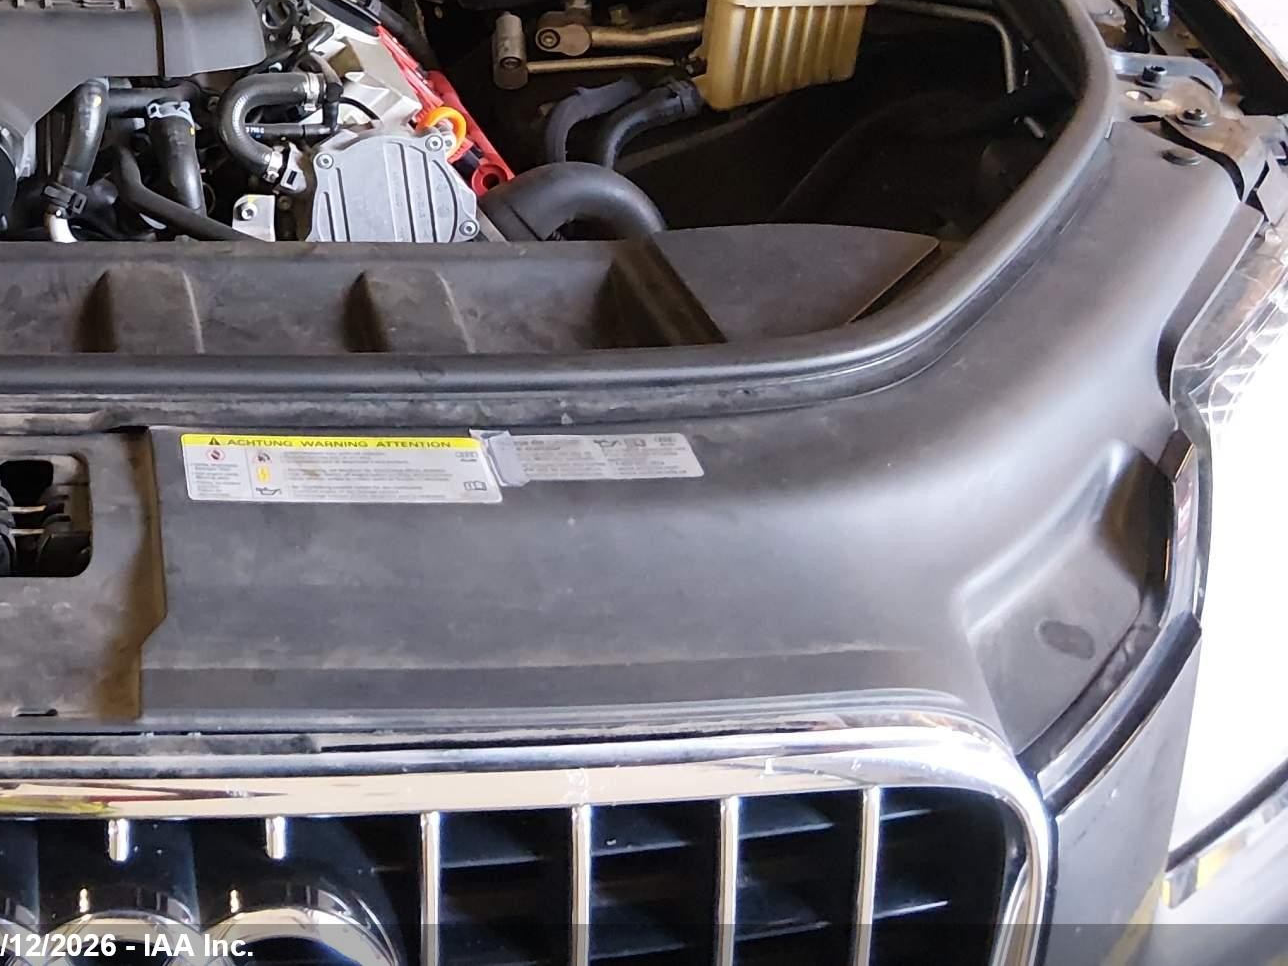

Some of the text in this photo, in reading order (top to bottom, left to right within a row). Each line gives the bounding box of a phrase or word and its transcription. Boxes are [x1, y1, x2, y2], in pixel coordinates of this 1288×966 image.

[226, 438, 452, 450] ACHTUNG WARNING ATTENTION
